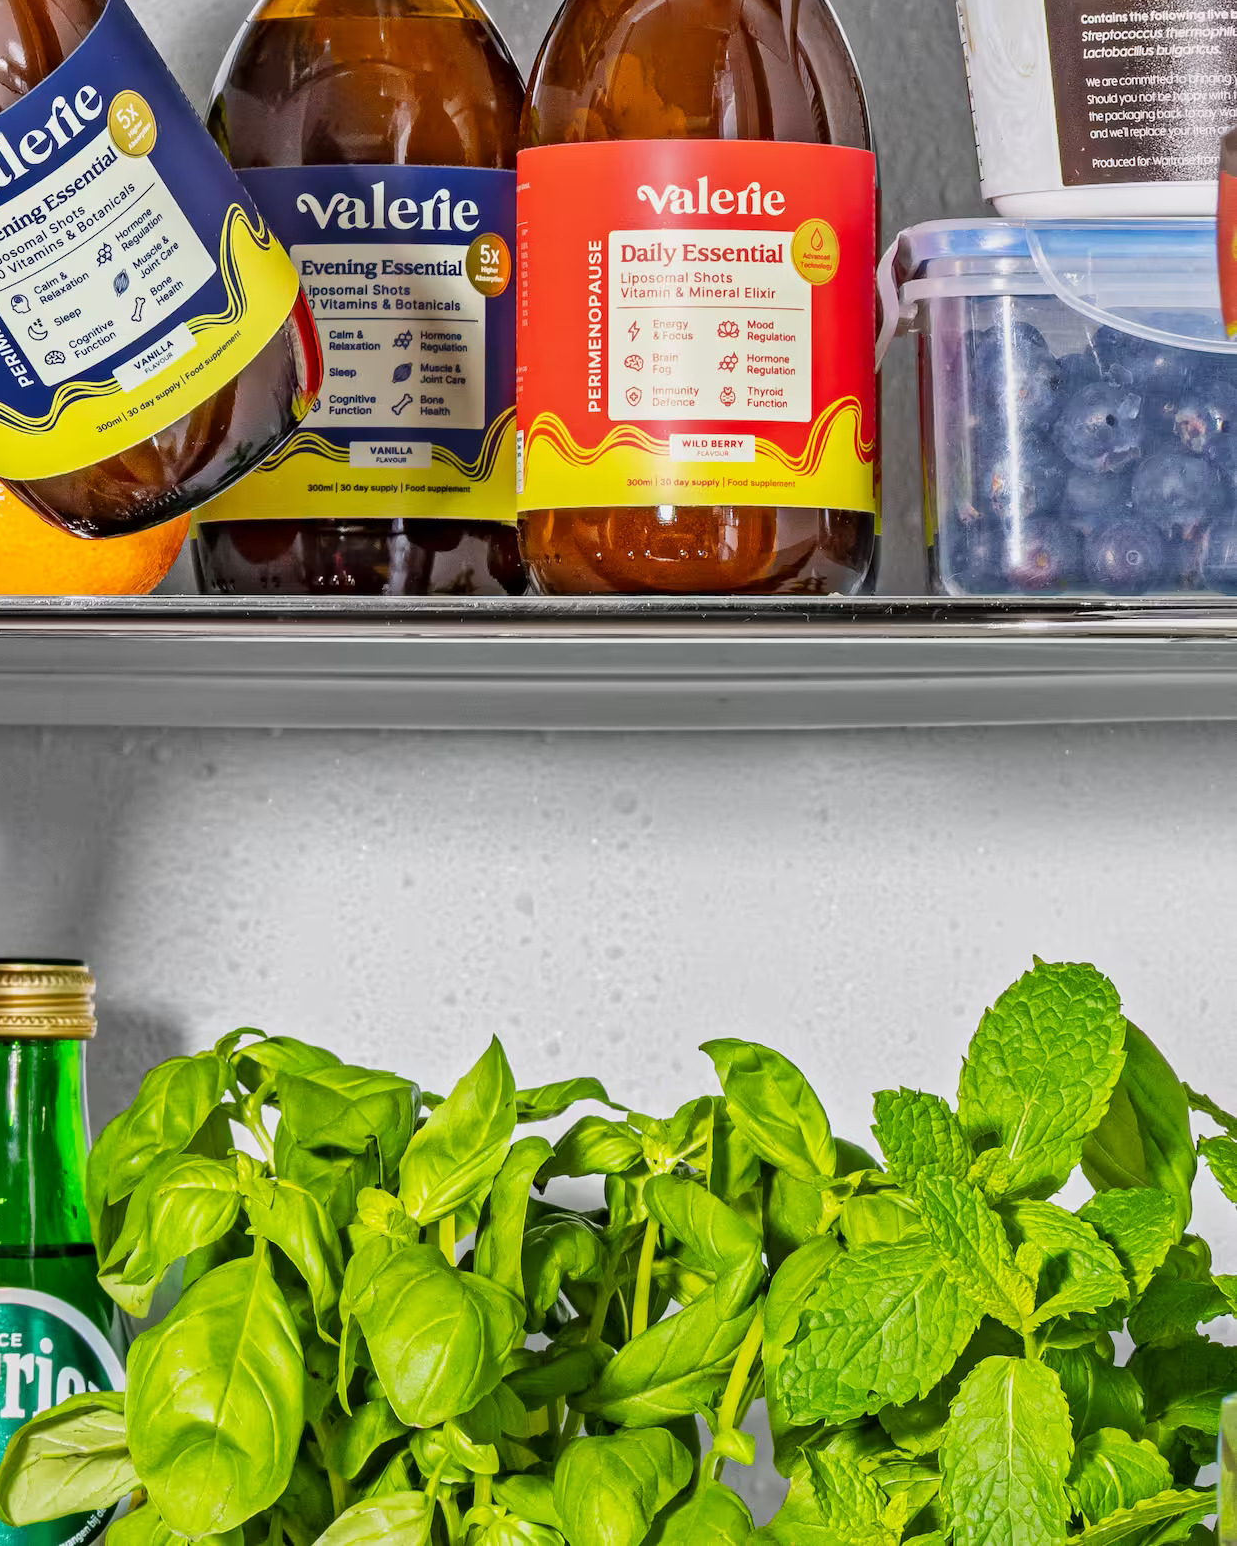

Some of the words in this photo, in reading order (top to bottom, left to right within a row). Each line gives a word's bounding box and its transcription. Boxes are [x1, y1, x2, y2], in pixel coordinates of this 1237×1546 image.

[1080, 12, 1128, 24] Contains
[1129, 11, 1149, 22] the
[1149, 9, 1206, 23] following
[1081, 28, 1164, 44] Streptococcus
[1083, 44, 1155, 59] Lactobacillus
[1085, 77, 1101, 88] We
[1101, 76, 1118, 87] are
[1087, 93, 1118, 105] Should
[1119, 93, 1138, 107] you
[1139, 91, 1156, 102] not
[1088, 111, 1104, 122] the
[1104, 109, 1156, 124] packaging
[1156, 108, 1182, 119] back
[1090, 128, 1109, 139] and
[1130, 126, 1168, 141] replace
[1092, 157, 1136, 169] Produced
[1137, 156, 1151, 167] for
[42, 145, 118, 212] Essential
[49, 206, 86, 234] Shots
[115, 208, 153, 242] Hormone
[7, 238, 64, 273] Vitamins
[65, 230, 77, 240] &
[76, 183, 136, 233] Botanicals
[121, 213, 164, 251] Regulation
[132, 243, 163, 269] Muscle
[140, 258, 161, 279] Joint
[160, 242, 179, 260] Care
[480, 244, 500, 265] 5x
[620, 242, 677, 267] Daily
[682, 243, 783, 263] Essential
[301, 259, 378, 279] Evening
[381, 259, 462, 277] Essential
[620, 272, 689, 286] Liposomal
[694, 272, 733, 283] Shots
[33, 277, 60, 295] Calm
[39, 272, 90, 304] Relaxation
[149, 276, 173, 296] Bone
[373, 284, 411, 295] Shots
[155, 280, 184, 306] Health
[620, 287, 671, 299] Vitamin
[675, 288, 684, 298] &
[689, 287, 740, 299] Mineral
[744, 287, 777, 299] Elixir
[320, 299, 378, 310] Vitamins
[383, 299, 391, 310] &
[397, 299, 461, 311] Botanicals
[53, 308, 82, 326] Sleep
[588, 239, 603, 414] PERIMENOPAUSE
[653, 319, 689, 330] Energy
[747, 320, 774, 329] Mood
[68, 320, 115, 349] Cognitive
[329, 330, 354, 339] Calm
[420, 331, 462, 341] Hormone
[747, 333, 796, 343] Regulation
[74, 331, 117, 359] Function
[329, 341, 381, 351] Relaxation
[420, 343, 467, 353] Regulation
[134, 340, 174, 370] VANILLA
[653, 353, 678, 362] Brain
[747, 354, 789, 363] Hormone
[145, 352, 174, 374] FLAVOUR
[420, 364, 452, 373] Muscle
[329, 368, 356, 378] Sleep
[653, 364, 672, 375] Fog
[747, 365, 796, 376] Regulation
[95, 416, 123, 433] 300ml
[127, 407, 139, 418] 30
[140, 398, 155, 411] day
[155, 381, 181, 401] supply
[184, 363, 204, 380] Food
[205, 330, 243, 366] supplement
[420, 375, 443, 384] Joint
[445, 375, 466, 384] Care
[653, 386, 700, 397] Immunity
[747, 386, 784, 397] Thyroid
[329, 395, 376, 405] Cognitive
[420, 395, 444, 404] Bone
[653, 398, 695, 407] Defence
[747, 399, 788, 408] Function
[329, 406, 372, 415] Function
[420, 407, 450, 416] Health
[682, 439, 708, 448] WILD
[711, 439, 744, 448] BERRY
[370, 446, 413, 455] VANILLA
[307, 484, 333, 492] 300ml
[340, 484, 351, 492] 30
[354, 484, 368, 493] day
[371, 484, 398, 493] supply
[405, 484, 425, 492] Food
[427, 485, 471, 493] supplement
[627, 478, 653, 486] 300ml
[660, 478, 672, 486] 30
[673, 478, 689, 487] day
[691, 479, 720, 487] supply
[728, 478, 748, 486] Food
[750, 479, 796, 488] supplement
